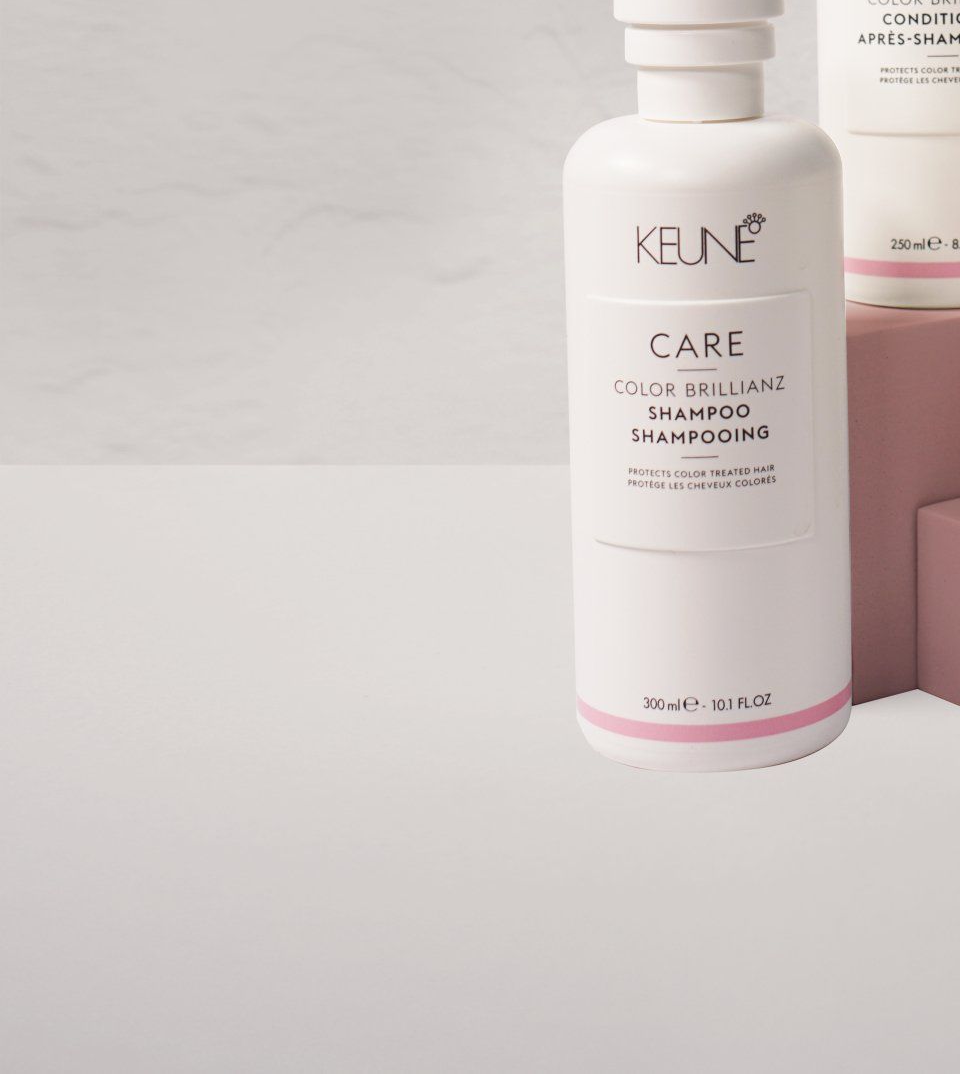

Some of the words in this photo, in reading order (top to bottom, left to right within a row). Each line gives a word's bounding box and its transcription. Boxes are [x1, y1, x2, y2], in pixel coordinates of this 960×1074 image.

[636, 225, 755, 265] KEUNE
[891, 239, 911, 250] 250
[650, 330, 744, 358] CARE
[614, 380, 676, 397] COLOR
[686, 376, 786, 398] BRILLIANZ
[648, 404, 750, 421] SHAMPOO
[632, 425, 770, 444] SHAMPOOING
[628, 468, 671, 478] PROTECTS
[674, 469, 706, 478] COLOR
[710, 468, 750, 477] TREATED
[753, 464, 775, 474] HAIR
[668, 481, 684, 490] LES
[687, 480, 732, 490] CHEVEUX
[735, 476, 776, 488] COLORÉS
[643, 697, 665, 710] 300
[712, 698, 732, 711] 10.1
[738, 693, 772, 710] FL.OZ
